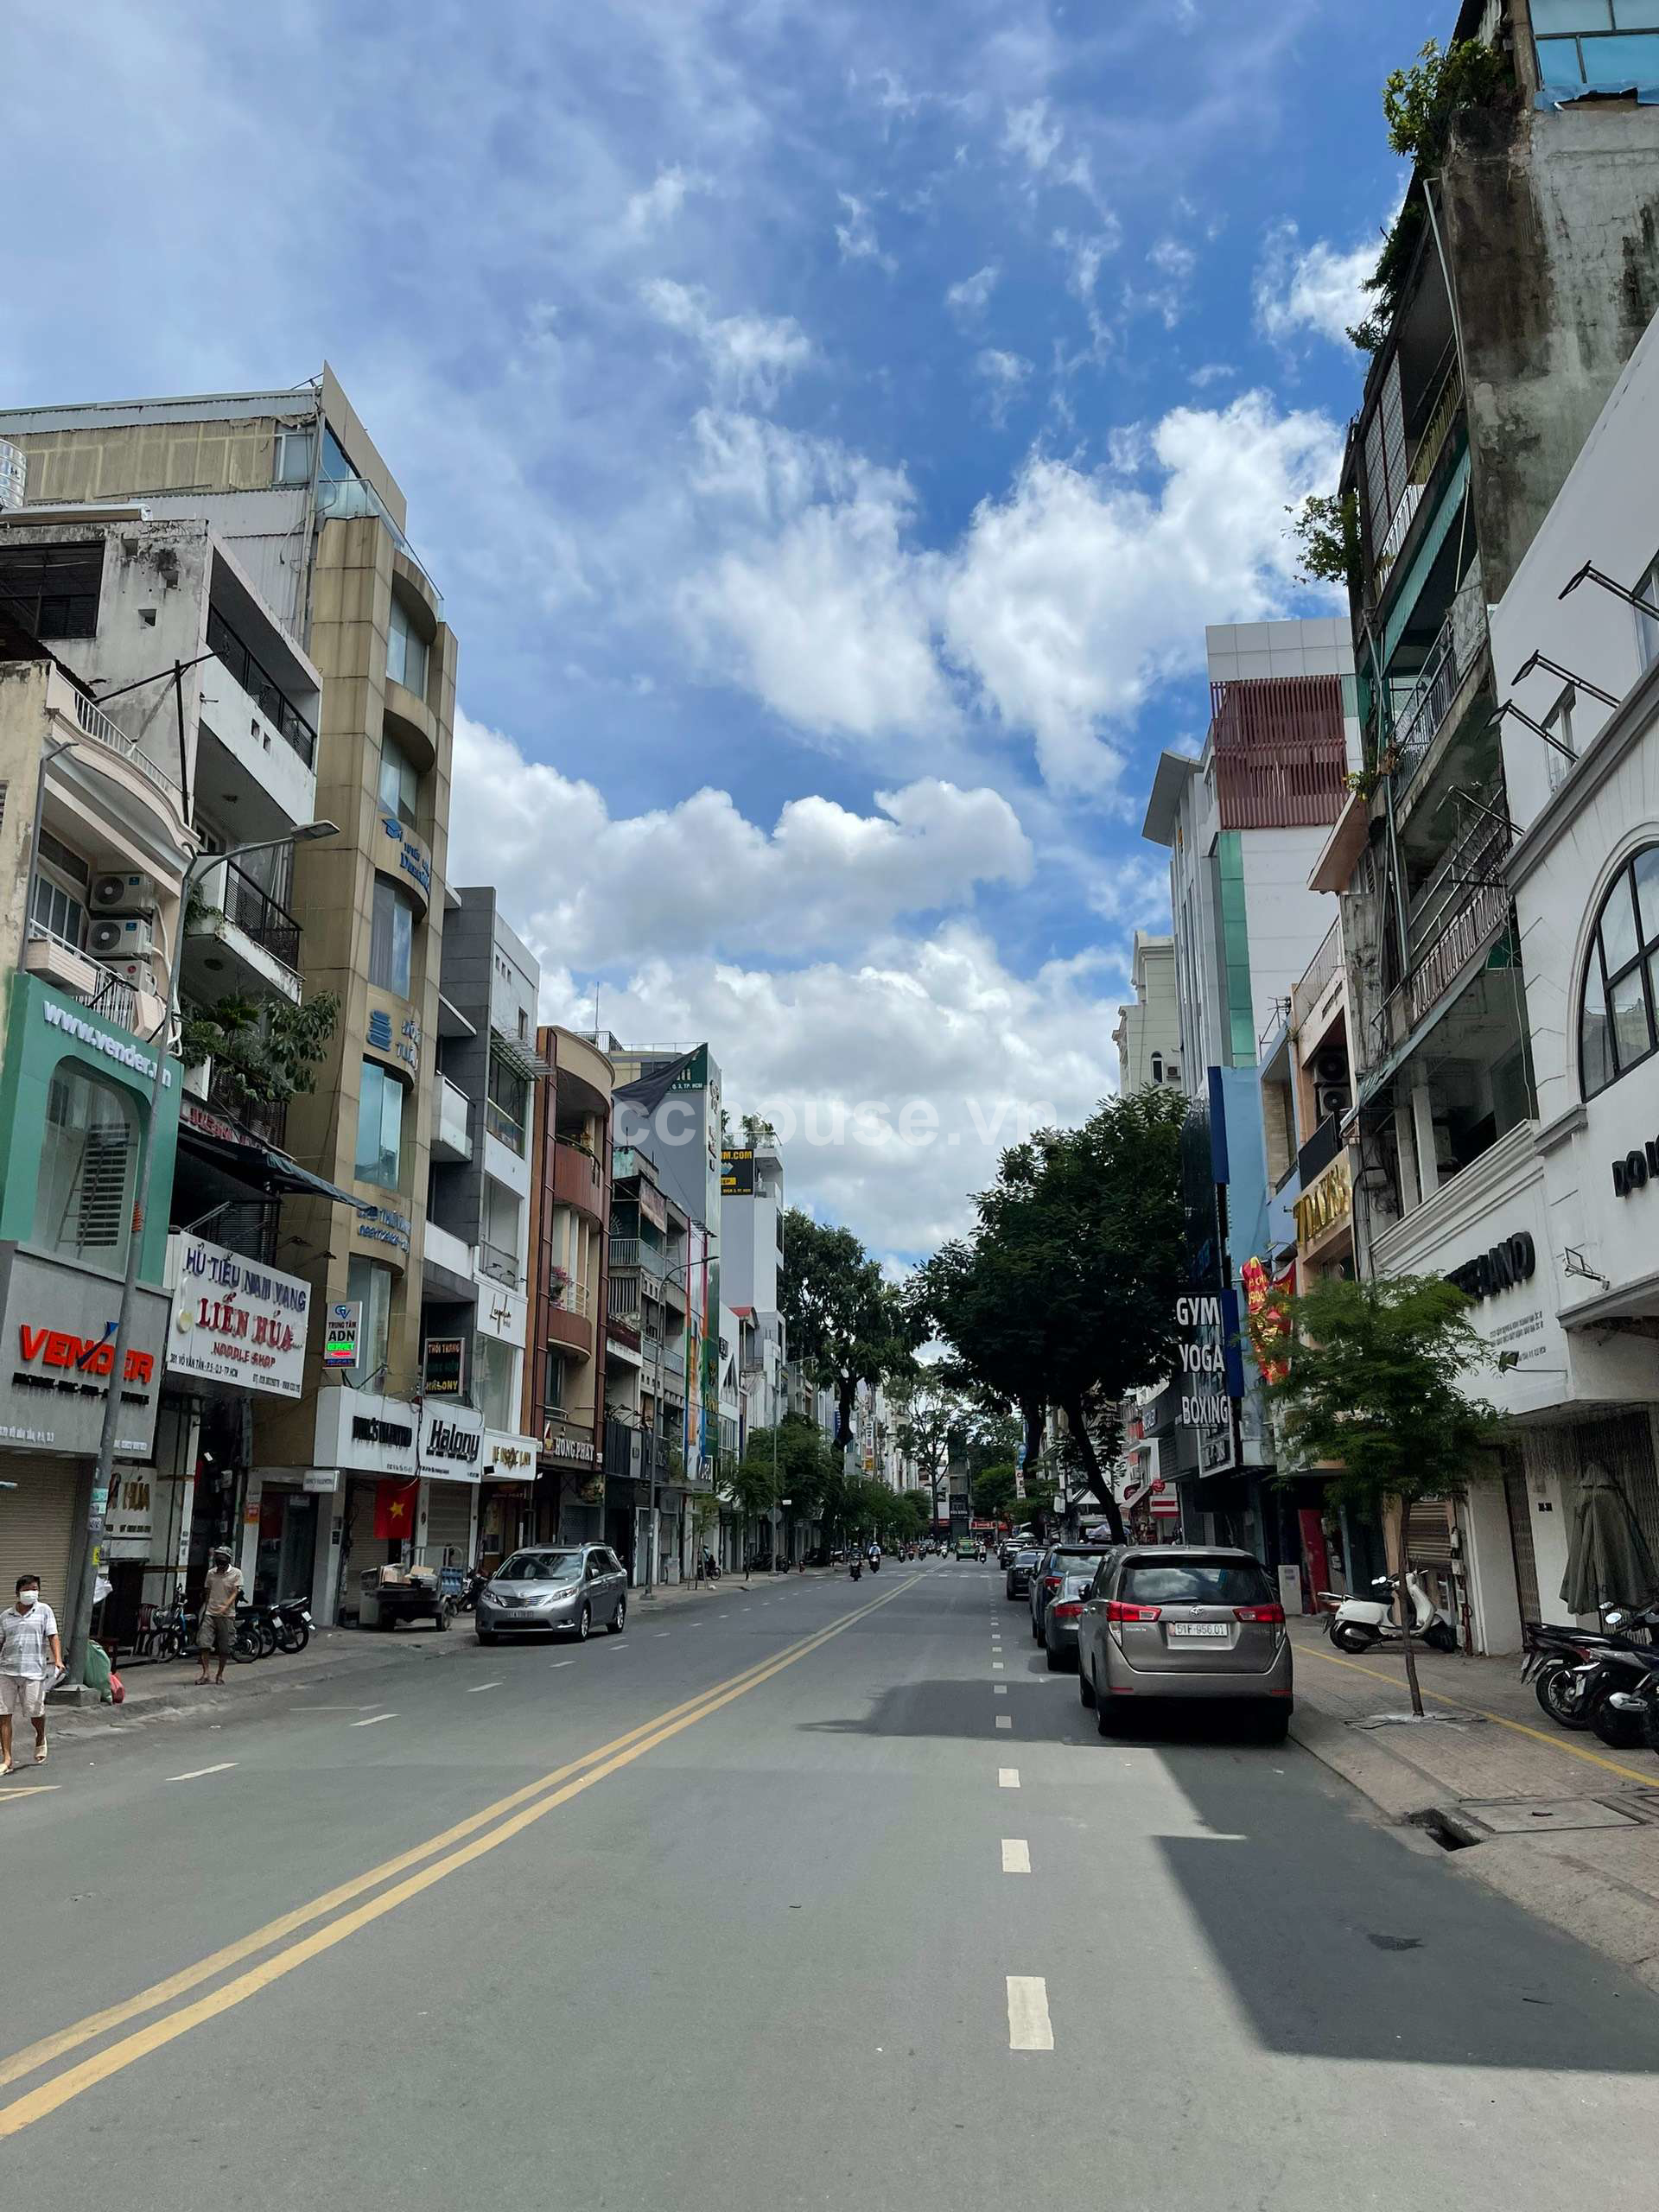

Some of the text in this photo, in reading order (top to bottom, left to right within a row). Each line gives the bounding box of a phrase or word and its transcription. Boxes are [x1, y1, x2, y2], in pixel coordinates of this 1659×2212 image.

[275, 1281, 307, 1313] VANG
[1176, 1297, 1220, 1325] GYM
[328, 1331, 355, 1341] ADN
[213, 1342, 276, 1369] NOODLE SHOP
[1179, 1344, 1225, 1373] YOGA
[1182, 1395, 1229, 1424] BOXING
[429, 1419, 480, 1462] Halony
